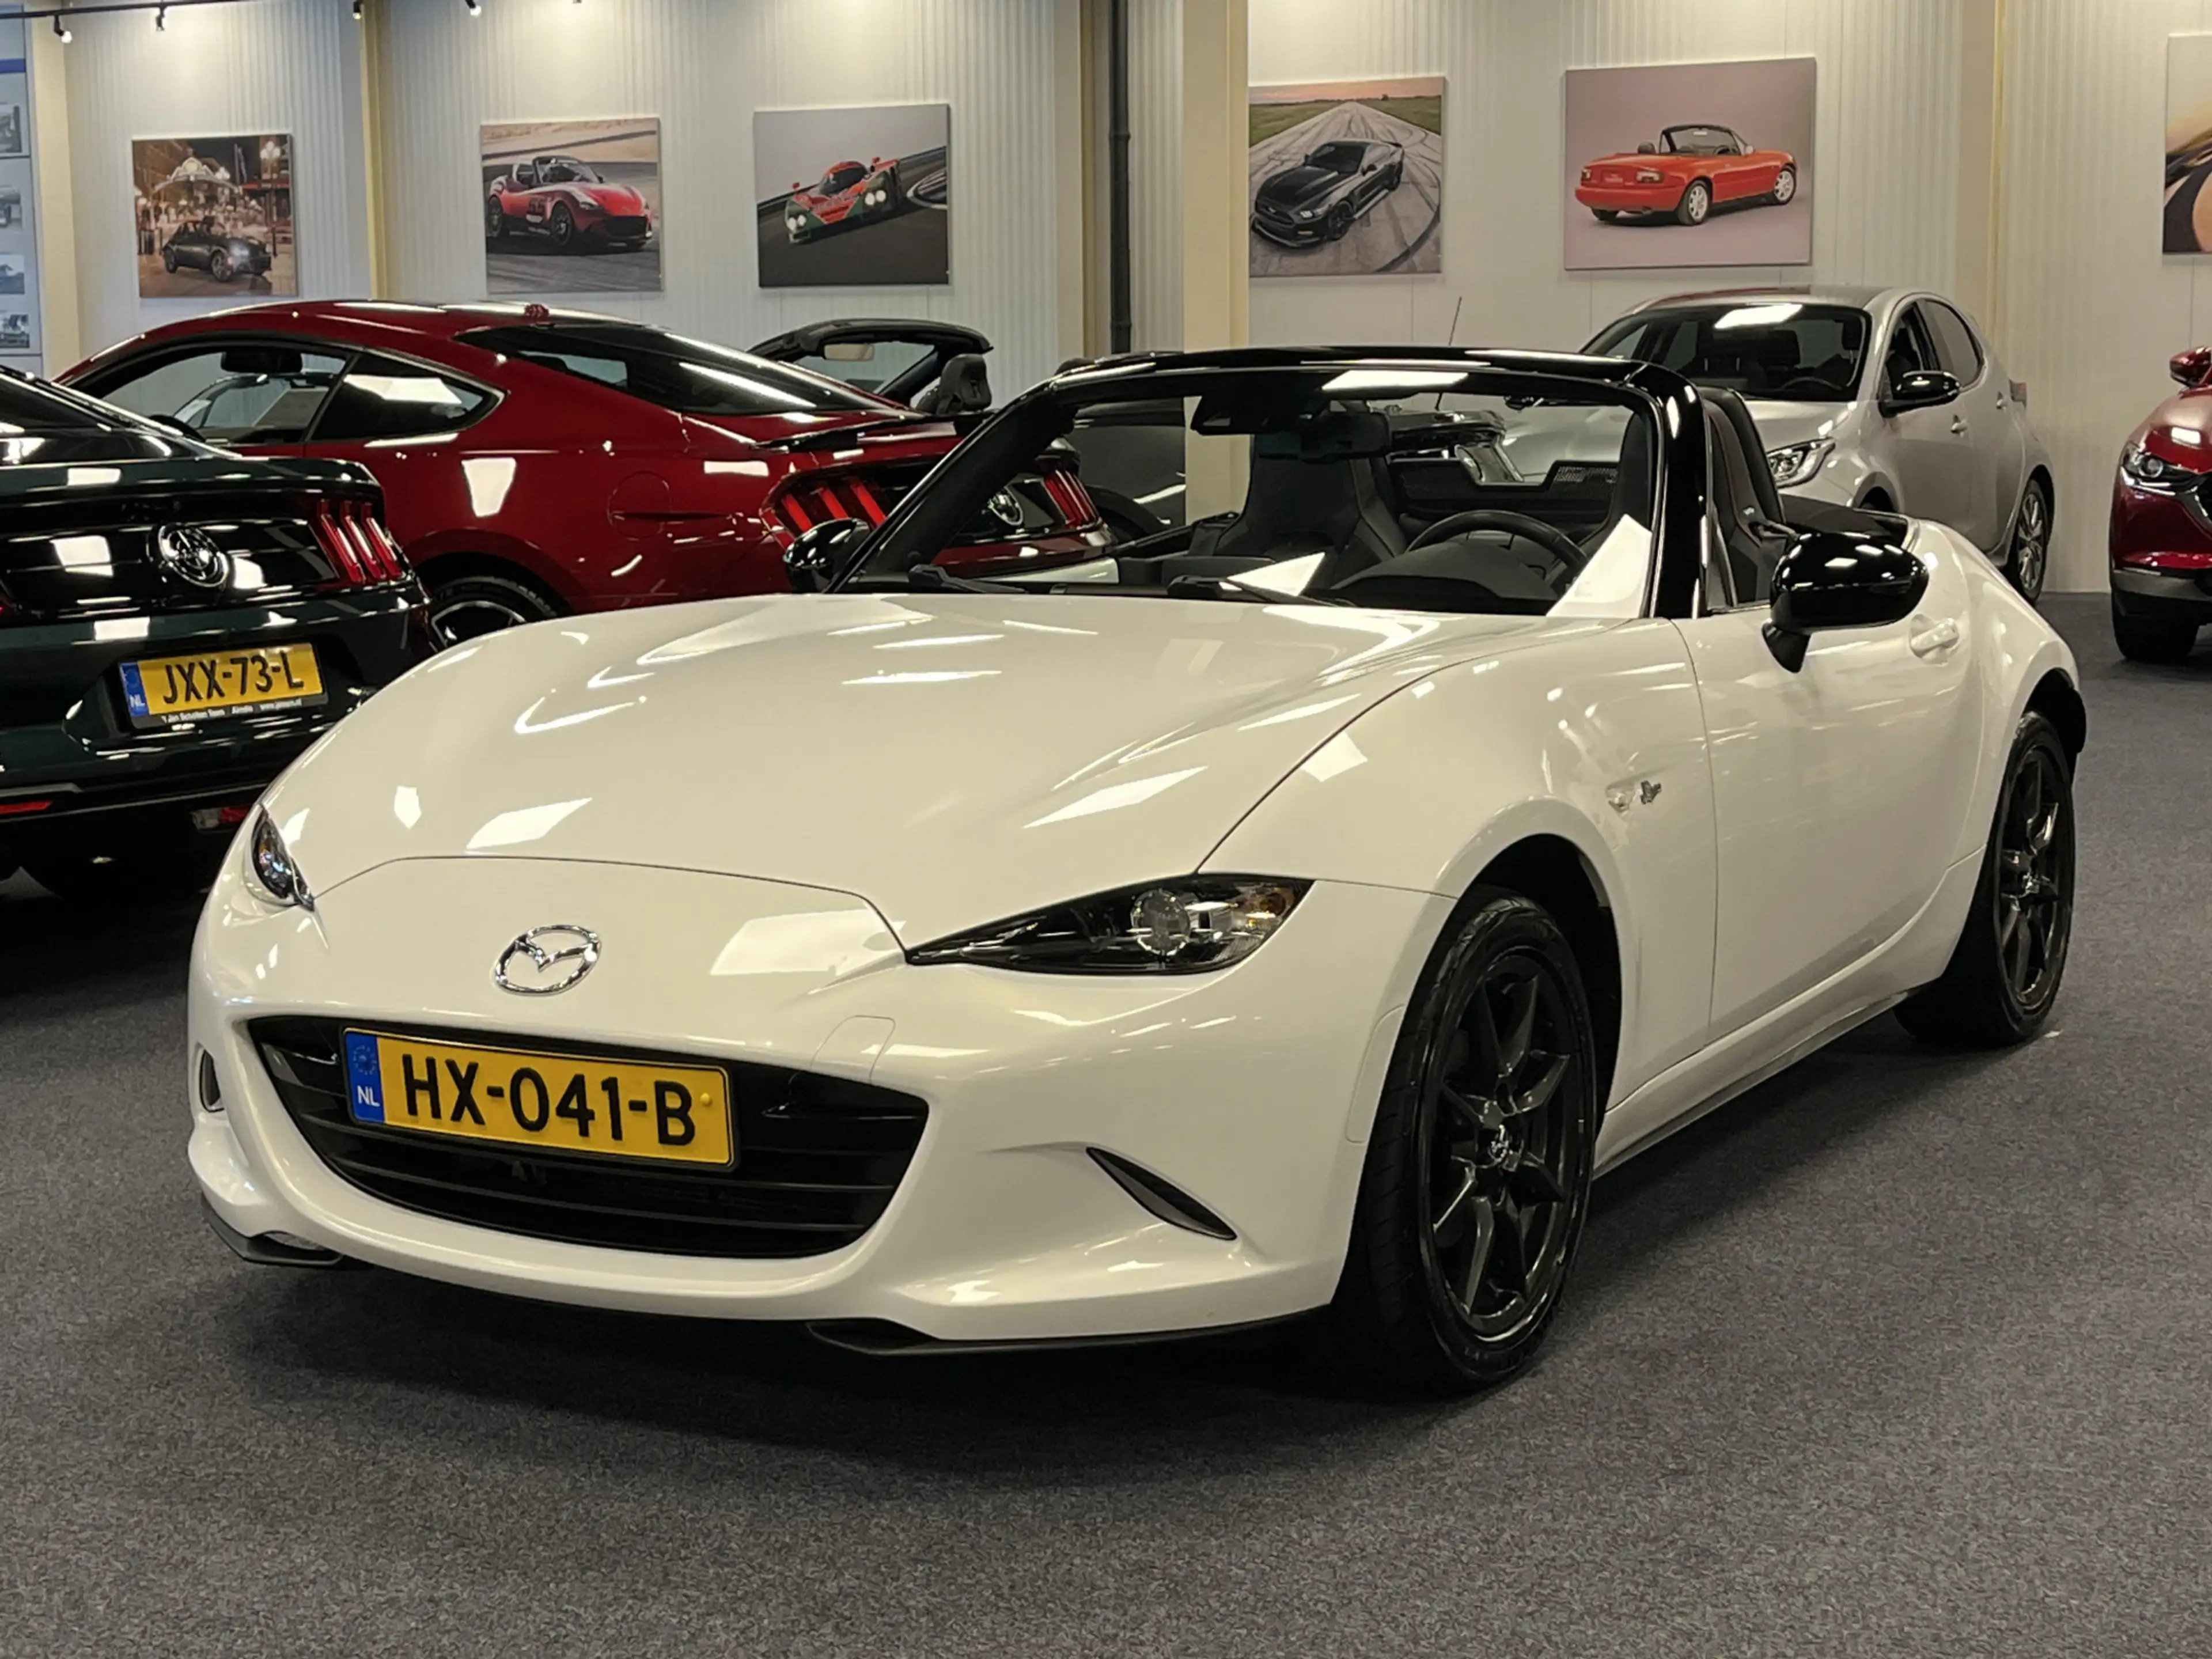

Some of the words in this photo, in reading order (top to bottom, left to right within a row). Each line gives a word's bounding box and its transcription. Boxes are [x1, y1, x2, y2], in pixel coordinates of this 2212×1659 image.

[163, 650, 304, 703] JXX-73-L
[129, 694, 146, 708] NL
[357, 1085, 380, 1108] NL
[402, 1053, 696, 1146] HX-041-B
